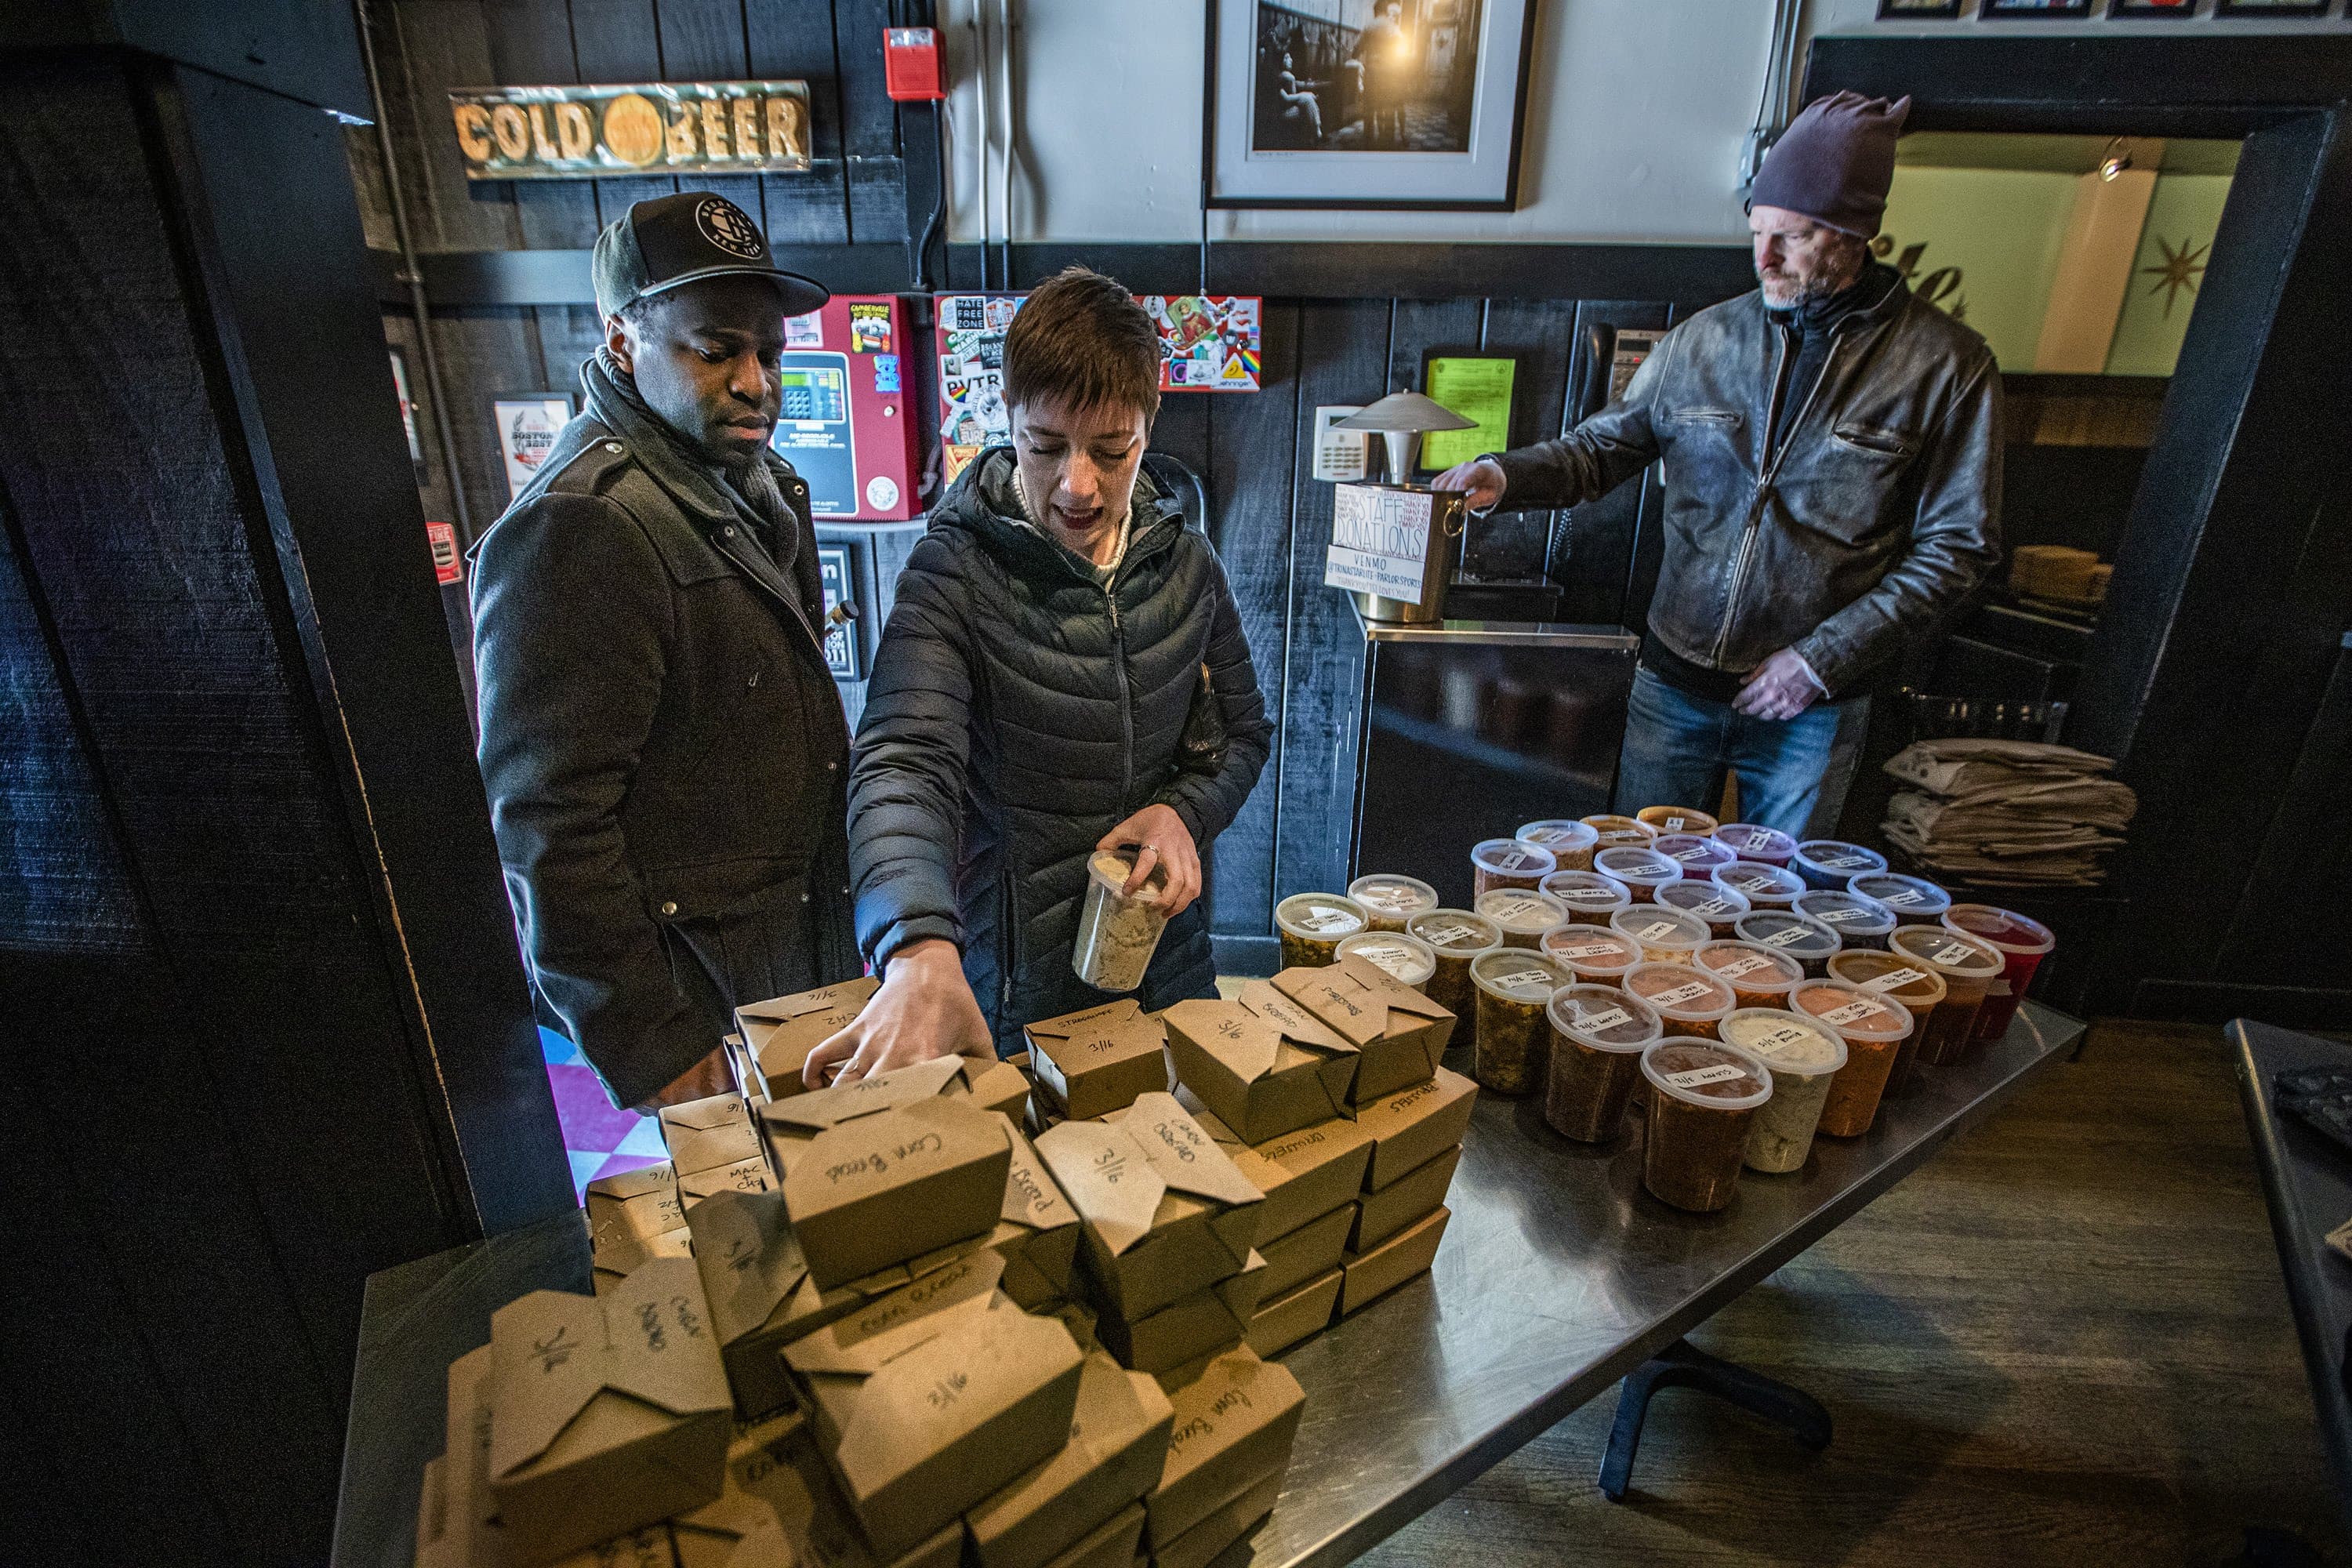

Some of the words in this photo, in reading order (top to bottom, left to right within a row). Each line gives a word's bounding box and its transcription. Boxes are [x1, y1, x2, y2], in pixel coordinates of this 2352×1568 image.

[453, 103, 593, 162] COLD
[665, 97, 800, 160] BEER
[956, 299, 983, 307] HATE
[957, 310, 983, 318] FREE
[947, 375, 999, 396] PVTR
[1359, 495, 1403, 524] STAFF
[1338, 517, 1423, 556] DONATIONS
[1354, 554, 1387, 571] VENMO
[833, 631, 844, 641] OF
[826, 641, 845, 650] TON
[808, 991, 837, 1001] 3/16
[1218, 1019, 1243, 1039] 3/16
[1578, 1021, 1598, 1029] 3/12
[1088, 1040, 1114, 1053] 3/16
[1673, 1075, 1696, 1086] 3/12
[894, 1132, 942, 1162] Corn
[730, 1165, 760, 1178] MAC
[1094, 1148, 1127, 1184] 3/16
